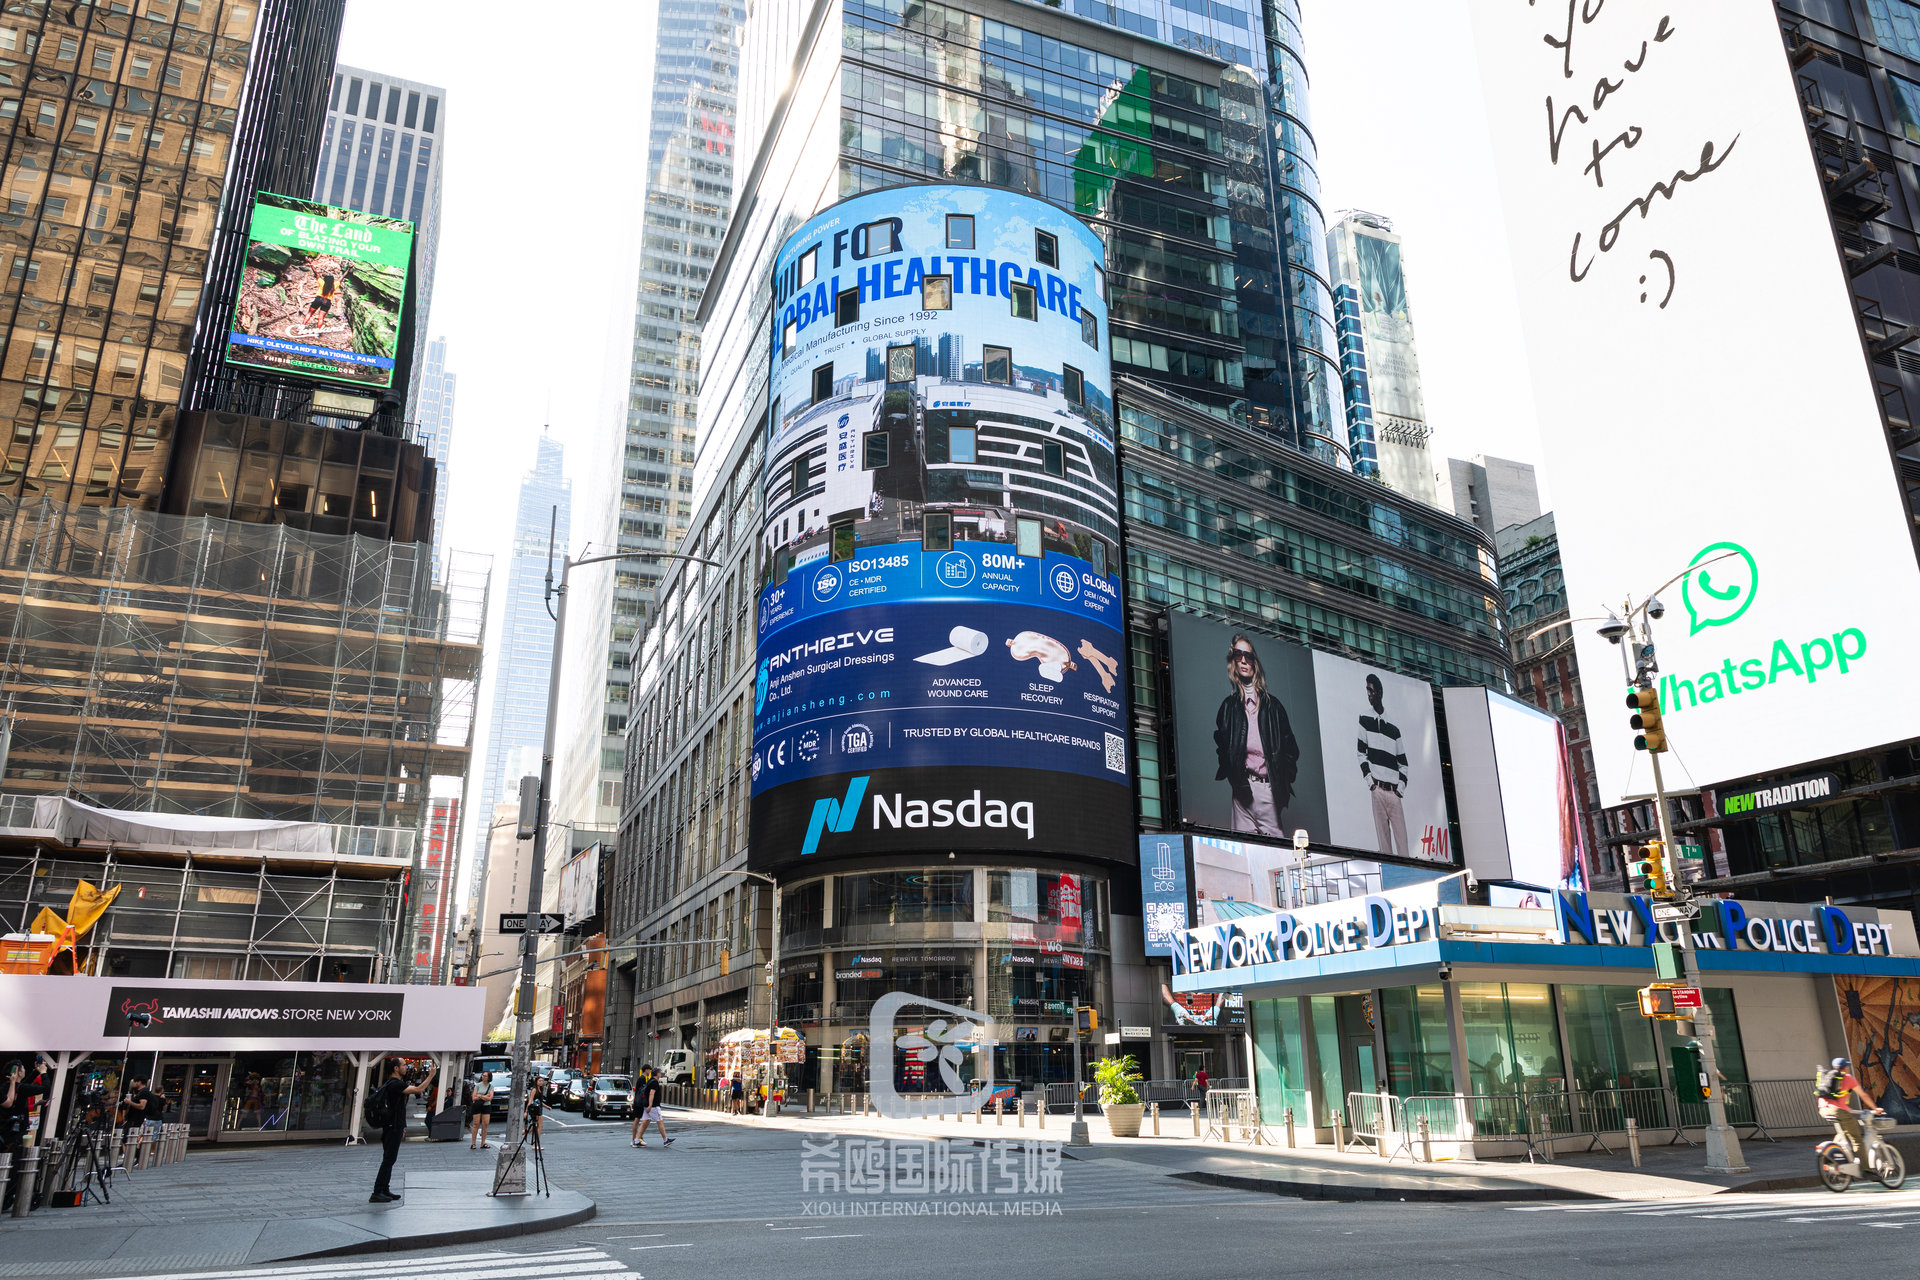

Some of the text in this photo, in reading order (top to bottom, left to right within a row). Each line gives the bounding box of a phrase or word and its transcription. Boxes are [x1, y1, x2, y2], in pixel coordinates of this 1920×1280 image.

[1546, 15, 1675, 165] have
[1584, 126, 1642, 187] to
[1570, 130, 1741, 282] come
[294, 215, 373, 243] The Land
[813, 217, 840, 237] POWER
[280, 228, 381, 253] OF BLAZING YOUR
[298, 239, 361, 258] OWN TRAIL
[805, 320, 870, 352] Manufacturing
[873, 314, 905, 328] Since
[909, 311, 938, 321] 1992
[247, 337, 377, 364] HIKE CLEVELAND'S NATIONAL PARK
[824, 342, 846, 356] TRUST
[862, 332, 893, 343] GLOBAL
[894, 328, 926, 338] SUPPLY
[848, 555, 909, 574] ISO13485
[982, 553, 1026, 570] 80M+
[817, 576, 838, 591] ISO
[848, 575, 882, 587] CE MDR
[981, 572, 1013, 582] ANNUAL
[1082, 573, 1117, 598] GLOBAL
[848, 585, 888, 597] CERTIFIED
[981, 582, 1021, 593] CAPACITY
[770, 588, 786, 606] 30+
[1084, 600, 1104, 612] EXPERT
[769, 652, 895, 690] Anji Anshen Surgical Dressings
[780, 684, 793, 697] Ltd.
[932, 678, 982, 687] ADVANCED
[1029, 682, 1054, 693] SLEEP
[927, 690, 989, 698] WOUND CARE
[1020, 693, 1064, 706] RECOVERY
[1083, 692, 1120, 710] RESPIRATORY
[1091, 705, 1116, 719] SUPPORT
[803, 740, 817, 749] MDR
[847, 732, 867, 748] TGA
[903, 728, 1101, 751] TRUSTED BY GLOBAL HEALTHCARE BRANDS
[873, 789, 1035, 840] Nasdaq
[428, 807, 447, 867] PARK
[1421, 824, 1448, 859] H&M
[1677, 906, 1693, 915] WAY
[506, 919, 525, 928] ONE
[1553, 890, 1633, 946] NEW
[1718, 900, 1820, 952] POLICE
[1819, 906, 1893, 955] DEPT
[416, 904, 435, 966] PARK
[1170, 895, 1439, 976] NEW YORK POLICE DEPT
[860, 956, 882, 964] Nasdaq
[1012, 956, 1035, 964] Nasdaq
[162, 1007, 222, 1019] TAMASHII
[282, 1009, 323, 1021] STORE
[326, 1009, 355, 1020] NEW
[357, 1010, 393, 1021] YORK
